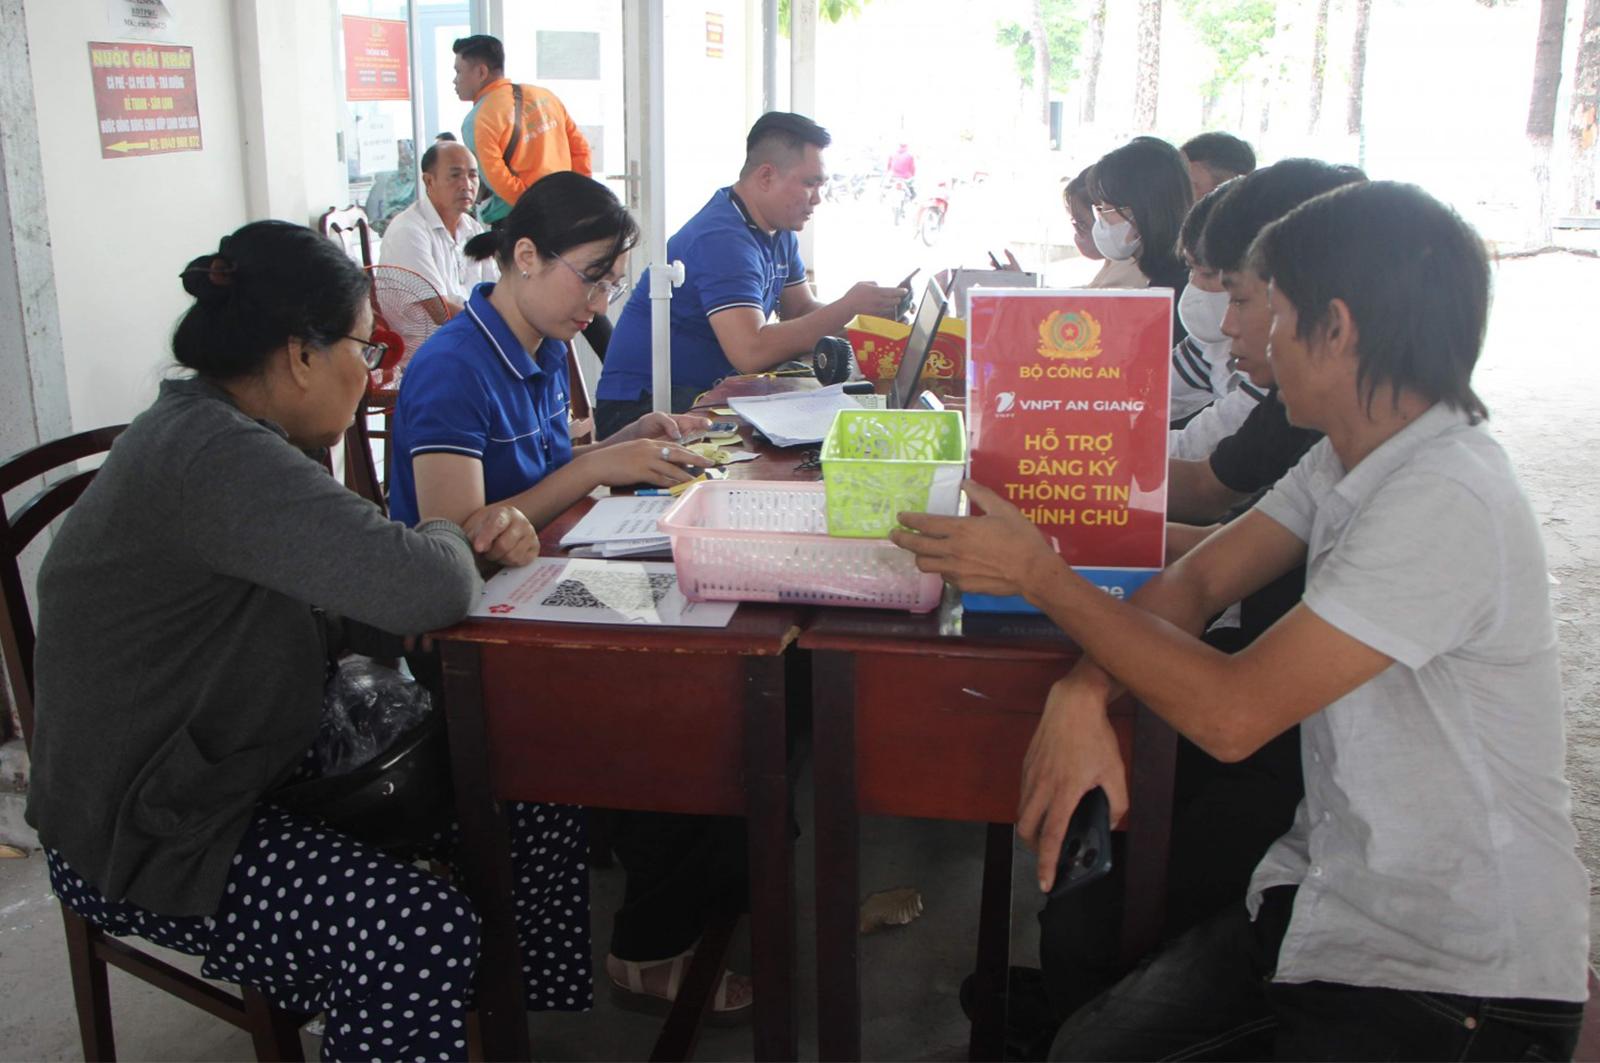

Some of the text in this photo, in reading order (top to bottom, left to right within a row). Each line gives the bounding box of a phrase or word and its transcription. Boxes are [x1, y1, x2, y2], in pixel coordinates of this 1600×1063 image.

[1020, 363, 1120, 380] BỘ CÔNG AN
[1020, 399, 1144, 412] VNPT AN GIANG
[1024, 427, 1113, 456] HỖ TRỢ
[1017, 455, 1119, 476] ĐĂNG KÝ
[1004, 480, 1129, 501] THÔNG TIN
[1021, 504, 1129, 526] HÍNH CHỦ
